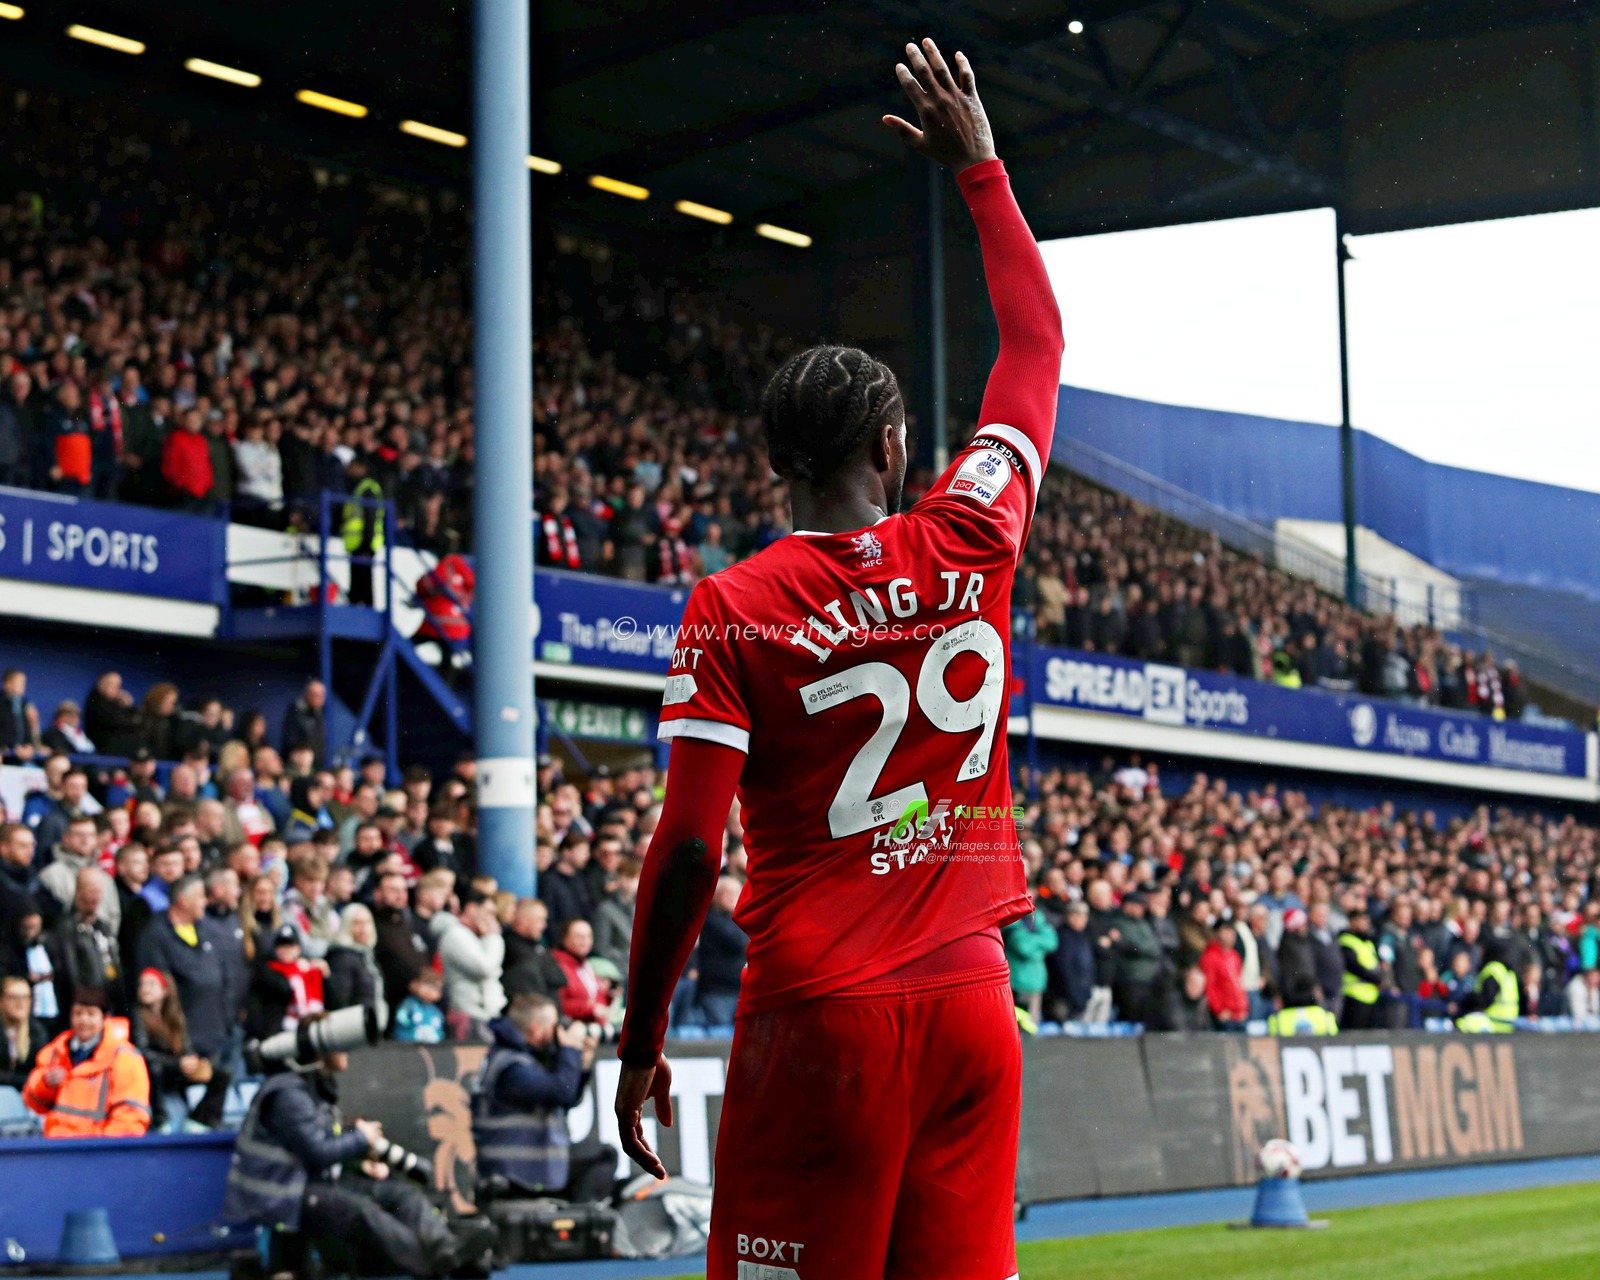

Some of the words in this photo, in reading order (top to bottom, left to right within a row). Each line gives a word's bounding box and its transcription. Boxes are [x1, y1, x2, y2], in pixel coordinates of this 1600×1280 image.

[987, 453, 1002, 466] EFL
[955, 481, 973, 490] bet
[973, 486, 992, 499] sky
[47, 521, 159, 574] SPORTS
[861, 559, 883, 569] MFC
[938, 571, 984, 612] JR
[672, 646, 704, 670] OXT
[799, 619, 1005, 840] 29
[969, 767, 980, 775] EFL
[872, 811, 950, 849] HOST
[873, 814, 885, 822] EFL
[1282, 1042, 1524, 1170] BETMGM
[737, 1233, 805, 1263] BOXT
